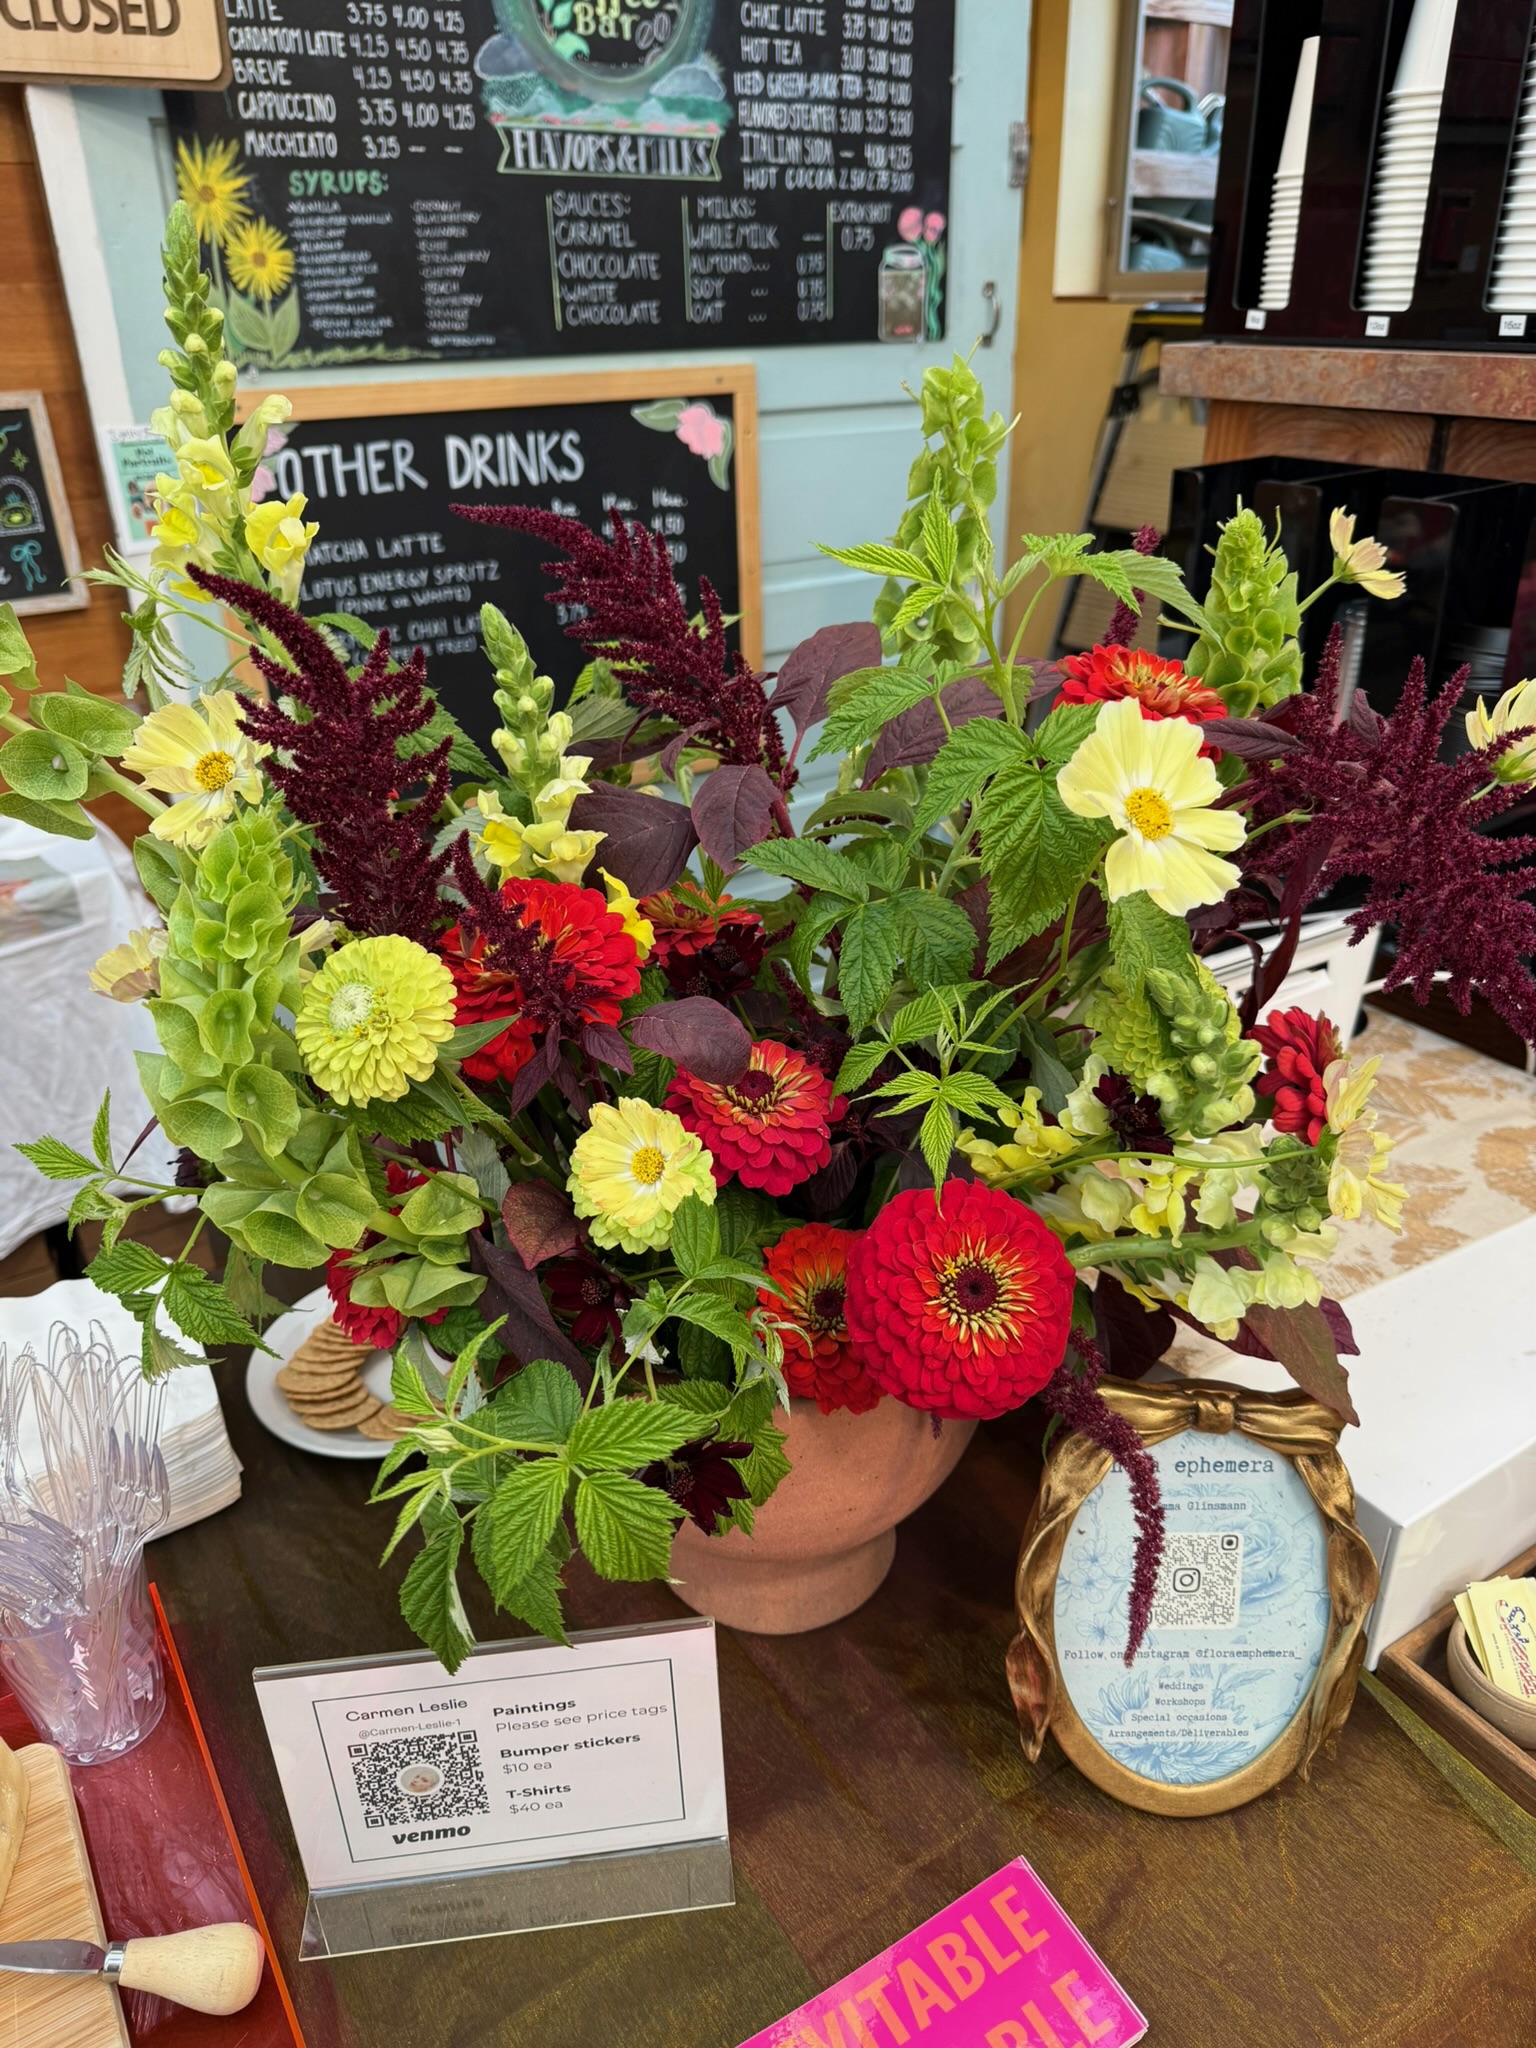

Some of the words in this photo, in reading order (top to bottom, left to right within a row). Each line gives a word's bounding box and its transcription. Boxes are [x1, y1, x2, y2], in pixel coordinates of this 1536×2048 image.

[0, 0, 180, 36] CLOSED
[223, 0, 284, 21] LATTE
[346, 2, 388, 27] 3.75
[392, 5, 429, 30] 4.00
[433, 9, 465, 34] 4.25
[573, 3, 640, 41] Bar
[740, 0, 781, 31] CHAI
[784, 5, 827, 36] LATTE
[228, 26, 304, 55] CARDAMOM
[304, 29, 347, 58] LATTE
[349, 33, 389, 58] 4.25
[395, 37, 432, 62] 4.50
[436, 40, 470, 65] 4.75
[740, 35, 770, 64] HOT
[773, 38, 803, 66] TEA
[841, 45, 865, 72] 3.00
[231, 57, 293, 86] BREVE
[352, 65, 392, 90] 4.25
[400, 69, 435, 93] 4.50
[439, 70, 473, 95] 4.75
[733, 70, 765, 96] ICED
[237, 90, 337, 123] CAPPUCCINO
[357, 97, 397, 127] 3.75
[402, 101, 440, 128] 4.00
[442, 103, 475, 130] 4.25
[738, 99, 789, 130] FLAVORED
[789, 103, 838, 133] STEAMER
[244, 130, 338, 158] MACCHIATO
[361, 134, 401, 159] 3.25
[739, 131, 802, 165] ITALIAN
[803, 137, 835, 167] SODA
[288, 169, 389, 197] SYRUPS:
[743, 167, 779, 190] HOT
[785, 167, 837, 191] COCOA
[553, 190, 631, 219] SAUCES:
[697, 197, 756, 219] MILKS:
[831, 202, 866, 223] EXTRA
[866, 203, 893, 223] SHOT
[555, 219, 637, 248] CARAMEL
[687, 222, 736, 250] WHOLE
[736, 223, 780, 249] MILK
[841, 225, 875, 251] 0.75
[559, 250, 661, 280] CHOCOLATE
[561, 281, 619, 303] WHITE
[690, 277, 725, 299] SOY
[566, 300, 661, 327] CHOCOLATE
[690, 301, 727, 324] OAT
[1503, 320, 1522, 330] 16oz
[276, 439, 429, 500] OTHER
[445, 429, 585, 490] DRINKS
[376, 532, 446, 559] LATTE
[301, 576, 357, 601] LOTUS
[359, 567, 428, 595] ENERGY
[433, 559, 500, 586] SPRITZ
[336, 596, 388, 615] (PINK
[412, 584, 471, 607] WHITE)
[407, 617, 448, 641] CHAI
[1174, 1456, 1274, 1477] ephemera
[1187, 1501, 1247, 1511] Glinsmann
[1064, 1650, 1104, 1659] Follow
[1110, 1651, 1123, 1659] on
[1137, 1649, 1190, 1661] nstagram
[1158, 1681, 1204, 1692] Weddings
[345, 1705, 414, 1722] Carmen
[419, 1699, 468, 1713] Leslie
[493, 1700, 576, 1717] Paintings
[1155, 1697, 1206, 1708] Workshops
[358, 1718, 461, 1740] @Carmen-Leslie-1
[496, 1720, 549, 1733] Please
[554, 1716, 582, 1726] see
[587, 1708, 627, 1724] price
[632, 1704, 668, 1717] tags
[1131, 1713, 1171, 1723] Special
[1176, 1713, 1228, 1722] occasions
[500, 1742, 570, 1758] Bumper
[574, 1733, 641, 1750] stickers
[1108, 1728, 1249, 1740] Arrangements/Deliverables
[502, 1762, 529, 1775] $10
[533, 1761, 552, 1771] ea
[506, 1783, 571, 1799] T-Shirts
[509, 1801, 540, 1815] $40
[545, 1801, 563, 1810] ea
[392, 1825, 471, 1845] venmo
